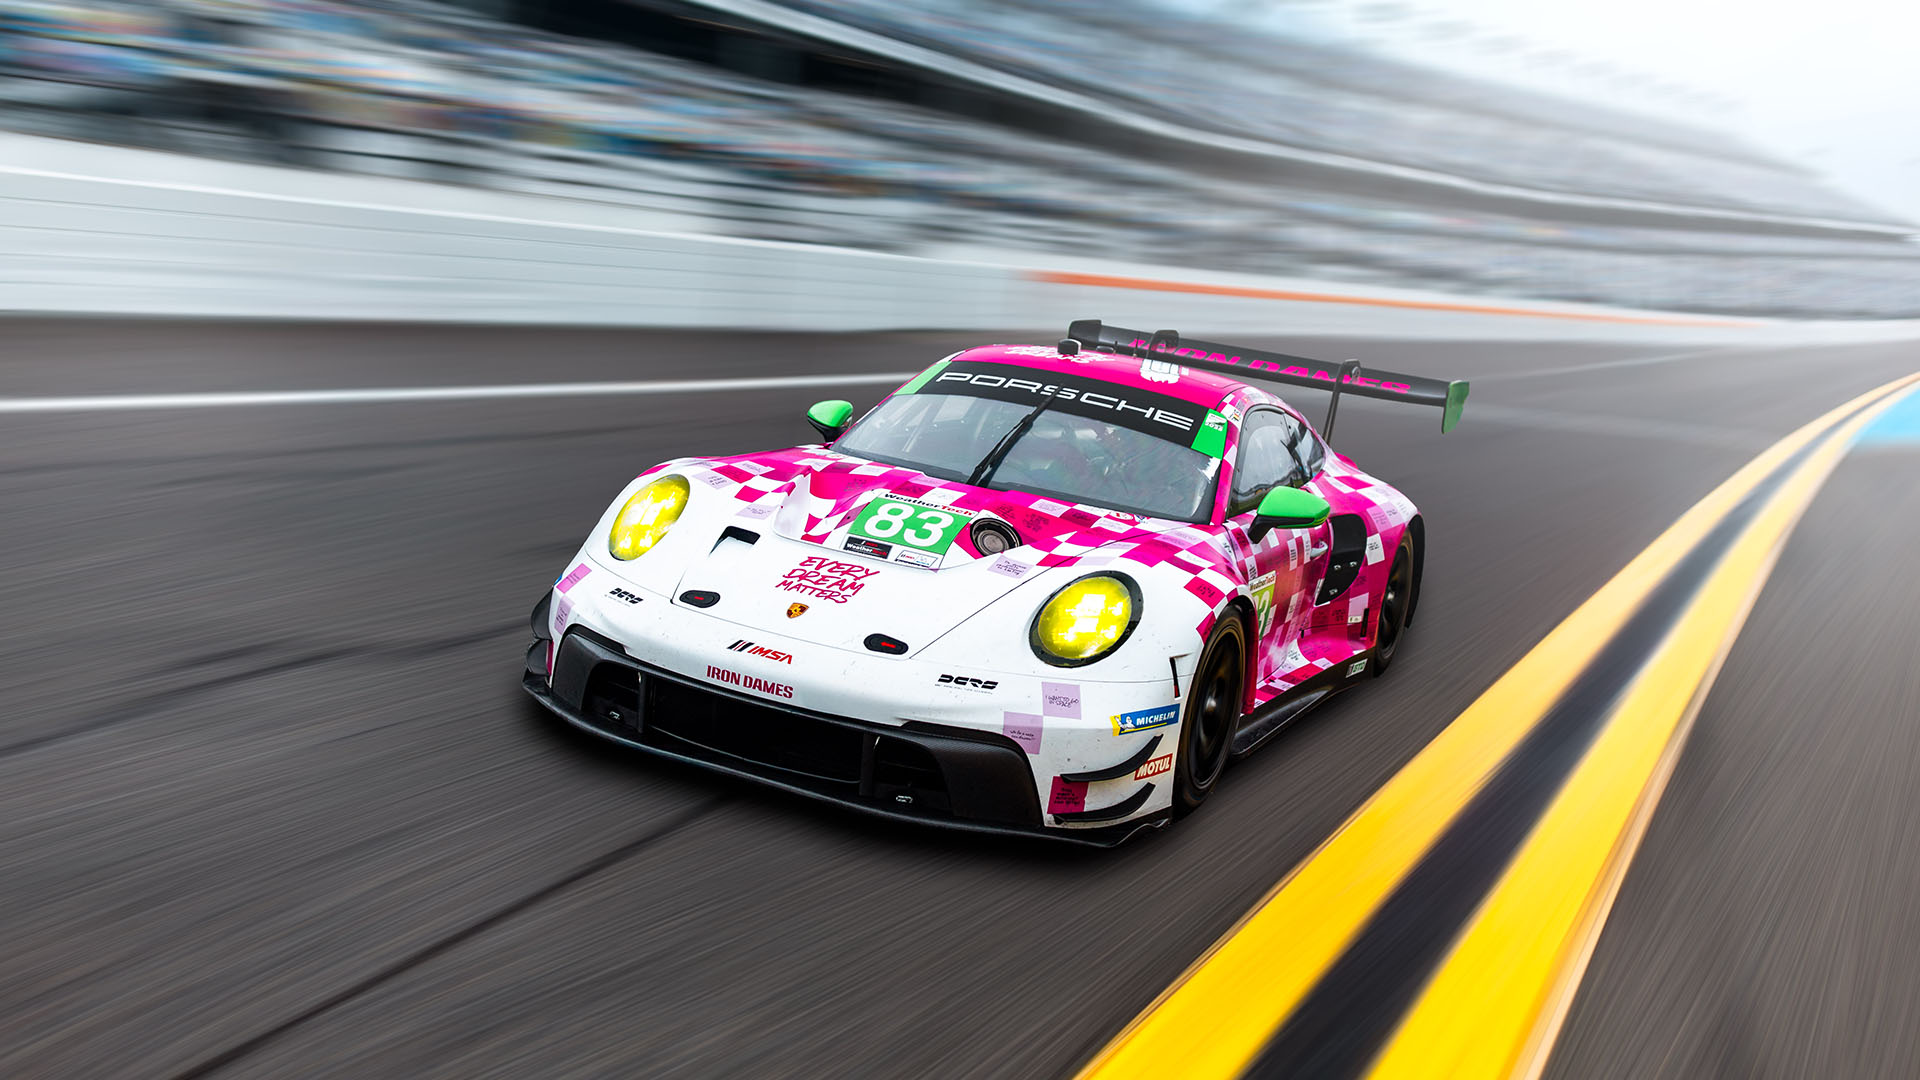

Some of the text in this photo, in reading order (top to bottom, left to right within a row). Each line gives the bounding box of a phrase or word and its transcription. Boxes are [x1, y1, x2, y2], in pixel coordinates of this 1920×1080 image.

[936, 372, 1194, 431] PORSCHE
[884, 493, 974, 517] WeatherTech
[864, 502, 954, 547] 83
[799, 556, 880, 581] EVERY
[775, 580, 852, 604] MATTERS
[782, 568, 864, 596] DREAM
[747, 646, 793, 665] IMSA
[706, 665, 794, 699] IRON DAMES
[1136, 711, 1177, 726] MICHELIN
[1136, 757, 1171, 778] MOTUL
